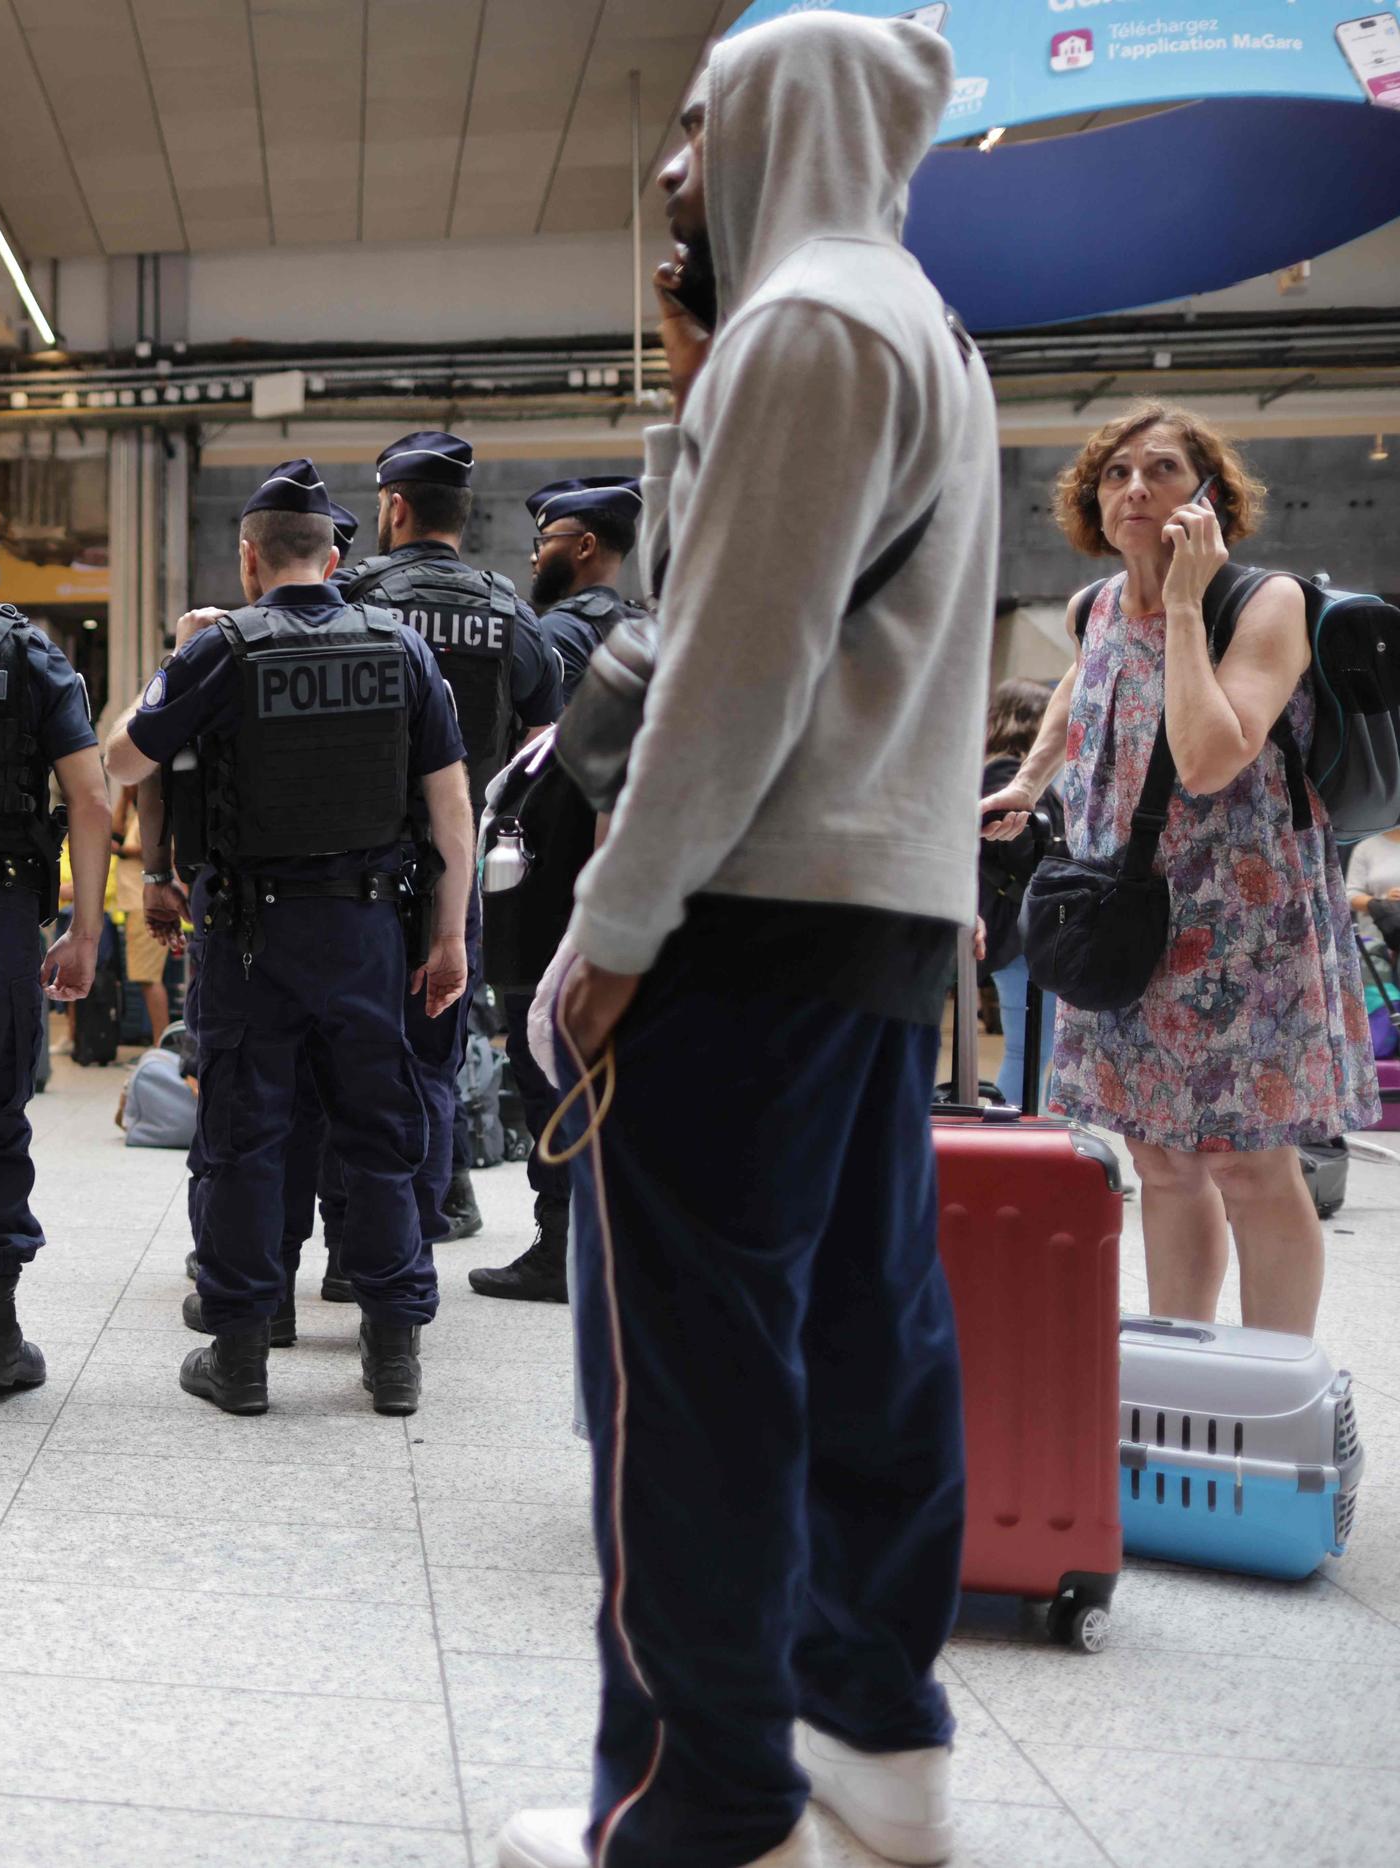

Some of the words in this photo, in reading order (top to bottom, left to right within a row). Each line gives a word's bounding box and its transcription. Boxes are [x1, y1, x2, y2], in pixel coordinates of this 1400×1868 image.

[1108, 18, 1220, 40] Téléchargez
[1232, 32, 1305, 50] MaGare
[262, 660, 400, 713] POLICE
